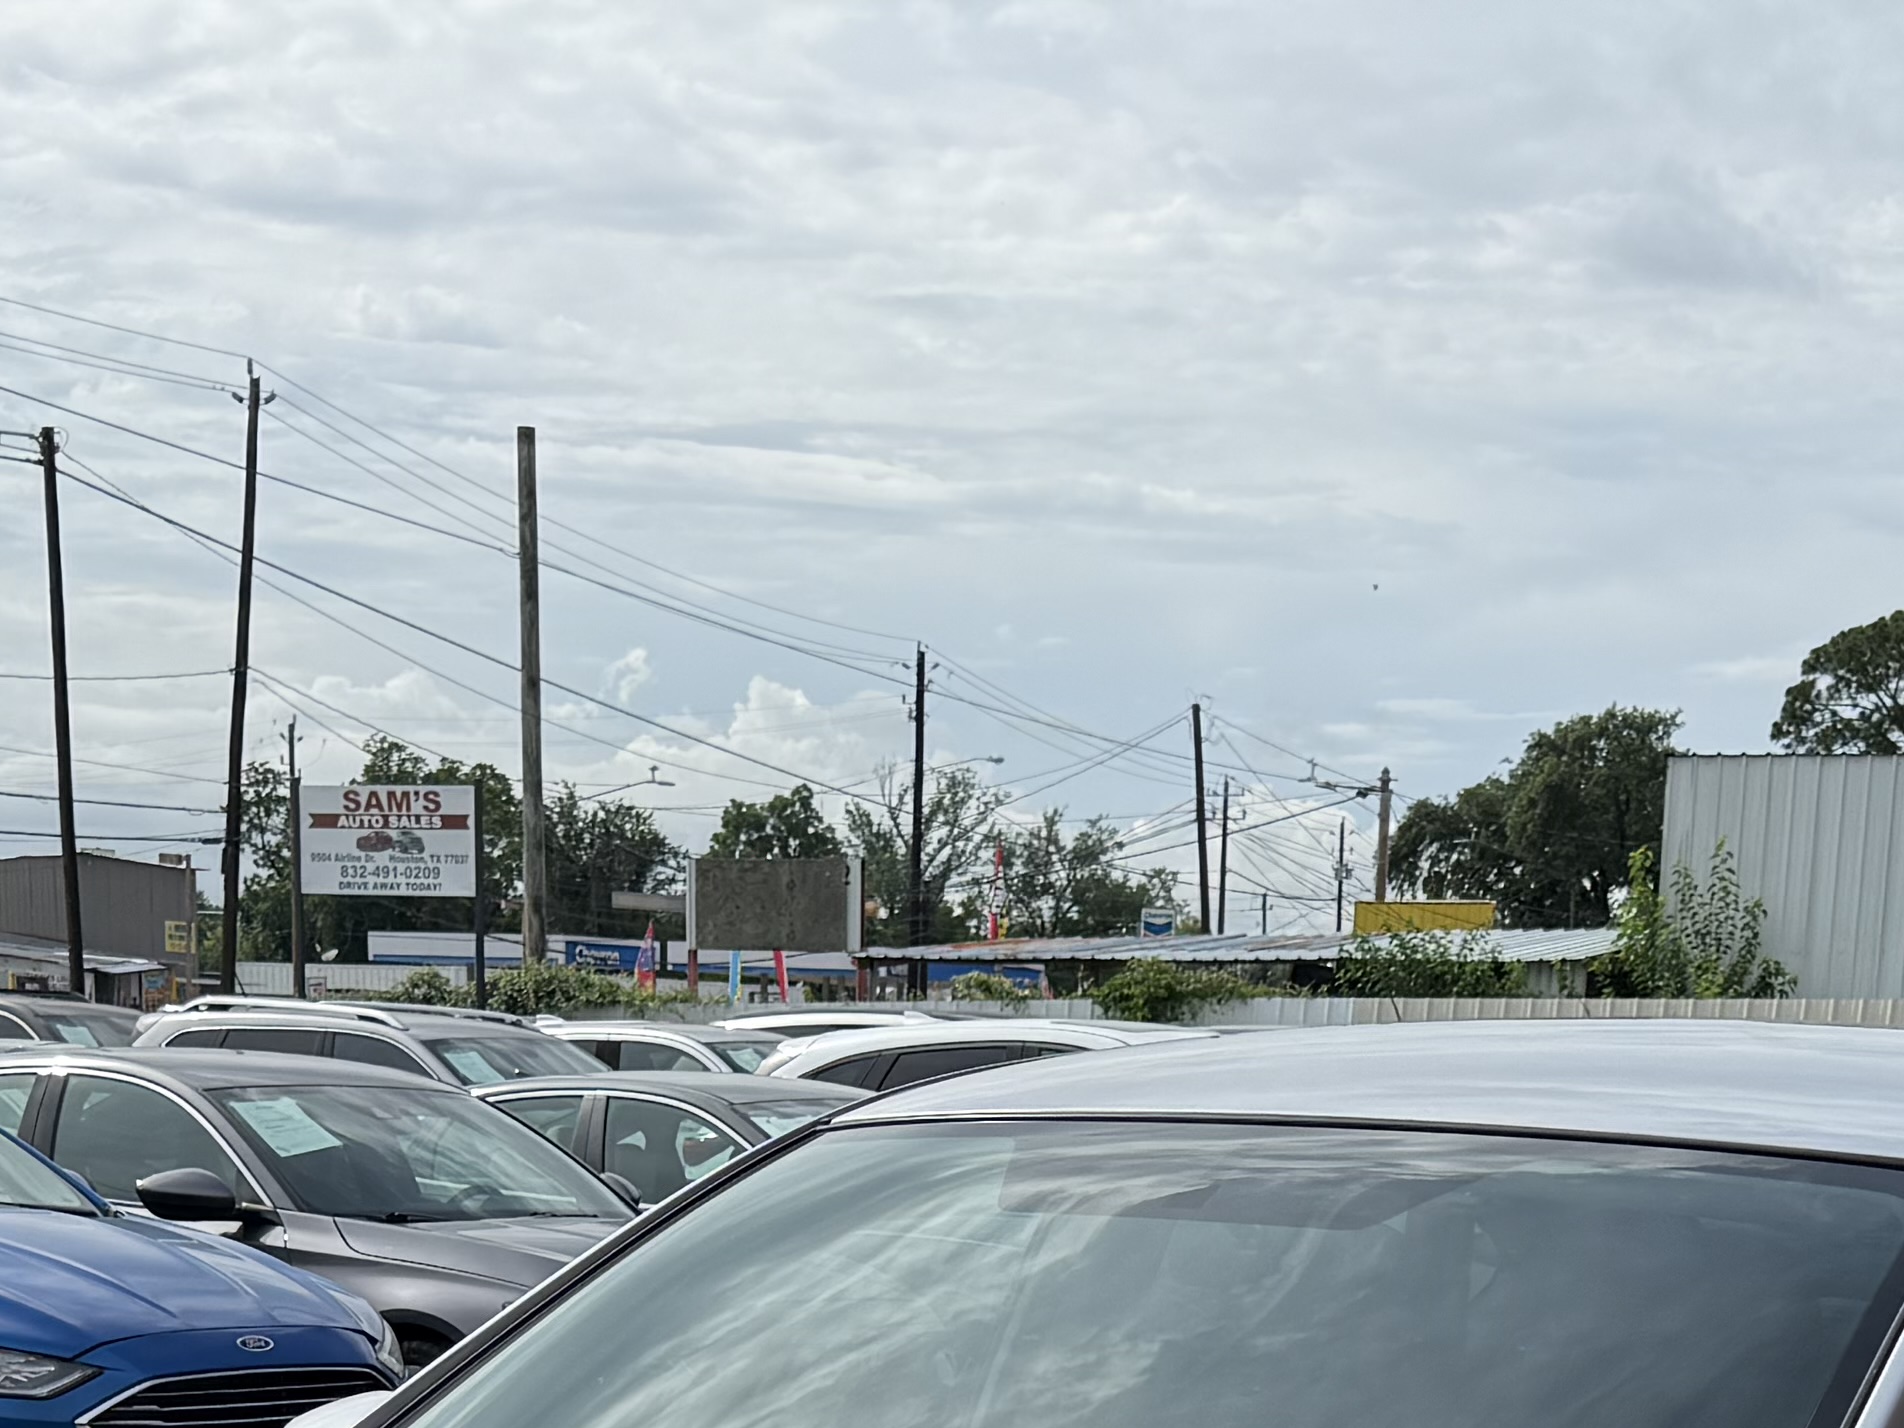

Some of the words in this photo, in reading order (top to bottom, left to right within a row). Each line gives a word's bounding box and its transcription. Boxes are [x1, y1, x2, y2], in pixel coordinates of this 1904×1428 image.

[342, 789, 442, 813] SAM'S
[337, 815, 383, 828] AUTO
[388, 816, 442, 829] SALES
[429, 854, 442, 864] TX
[340, 865, 441, 880] 832-491-0209
[338, 881, 369, 891] DRIVE
[372, 882, 401, 892] AWAY
